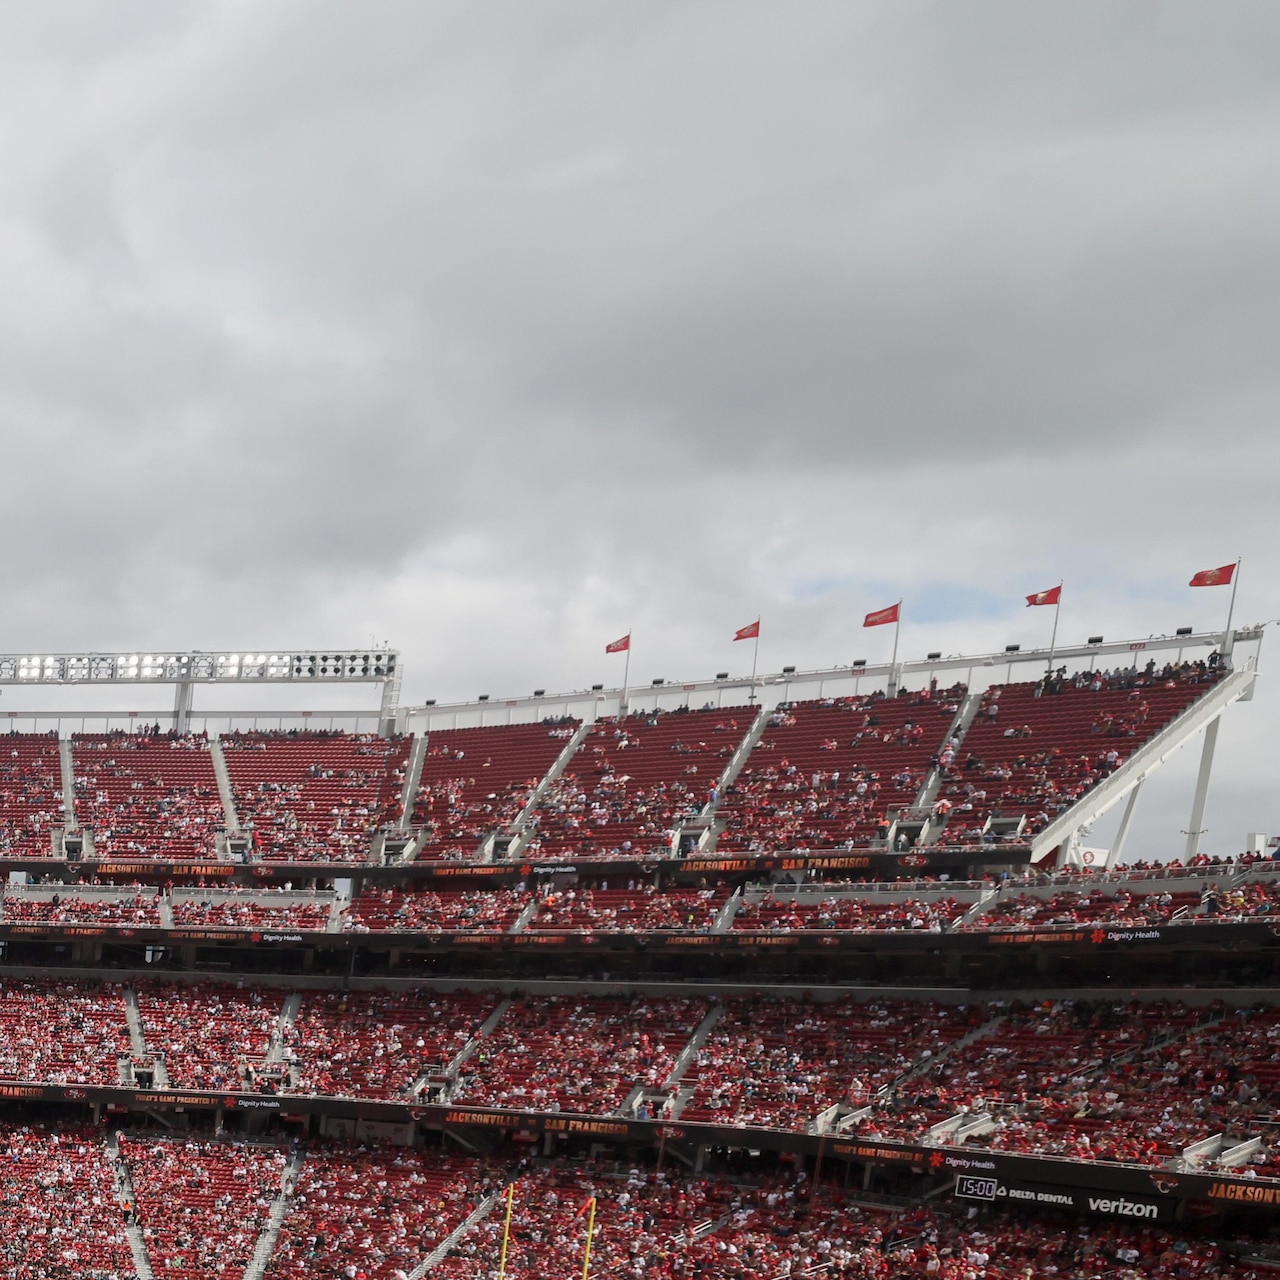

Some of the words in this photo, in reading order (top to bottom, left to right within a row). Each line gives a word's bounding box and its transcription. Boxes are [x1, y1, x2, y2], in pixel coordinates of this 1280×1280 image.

[96, 864, 154, 873] JACKSONVILLE
[172, 866, 189, 874] SAN
[191, 866, 234, 875] FRANCISCO
[680, 859, 756, 871] JACKSONVILLE
[782, 859, 804, 870] SAN
[807, 857, 869, 869] FRANCISCO
[1107, 932, 1133, 941] Dignity
[1134, 930, 1160, 939] Health
[238, 1099, 260, 1108] Dignity
[446, 1112, 519, 1127] JACKSONVILLE
[544, 1118, 566, 1130] SAN
[568, 1119, 628, 1135] FRANCISCO
[945, 1157, 970, 1168] Dignity
[970, 1159, 995, 1169] Health
[962, 1180, 994, 1197] 15:00
[1009, 1189, 1035, 1200] DELTA
[1037, 1192, 1073, 1205] DENTAL
[1088, 1196, 1158, 1218] verizon
